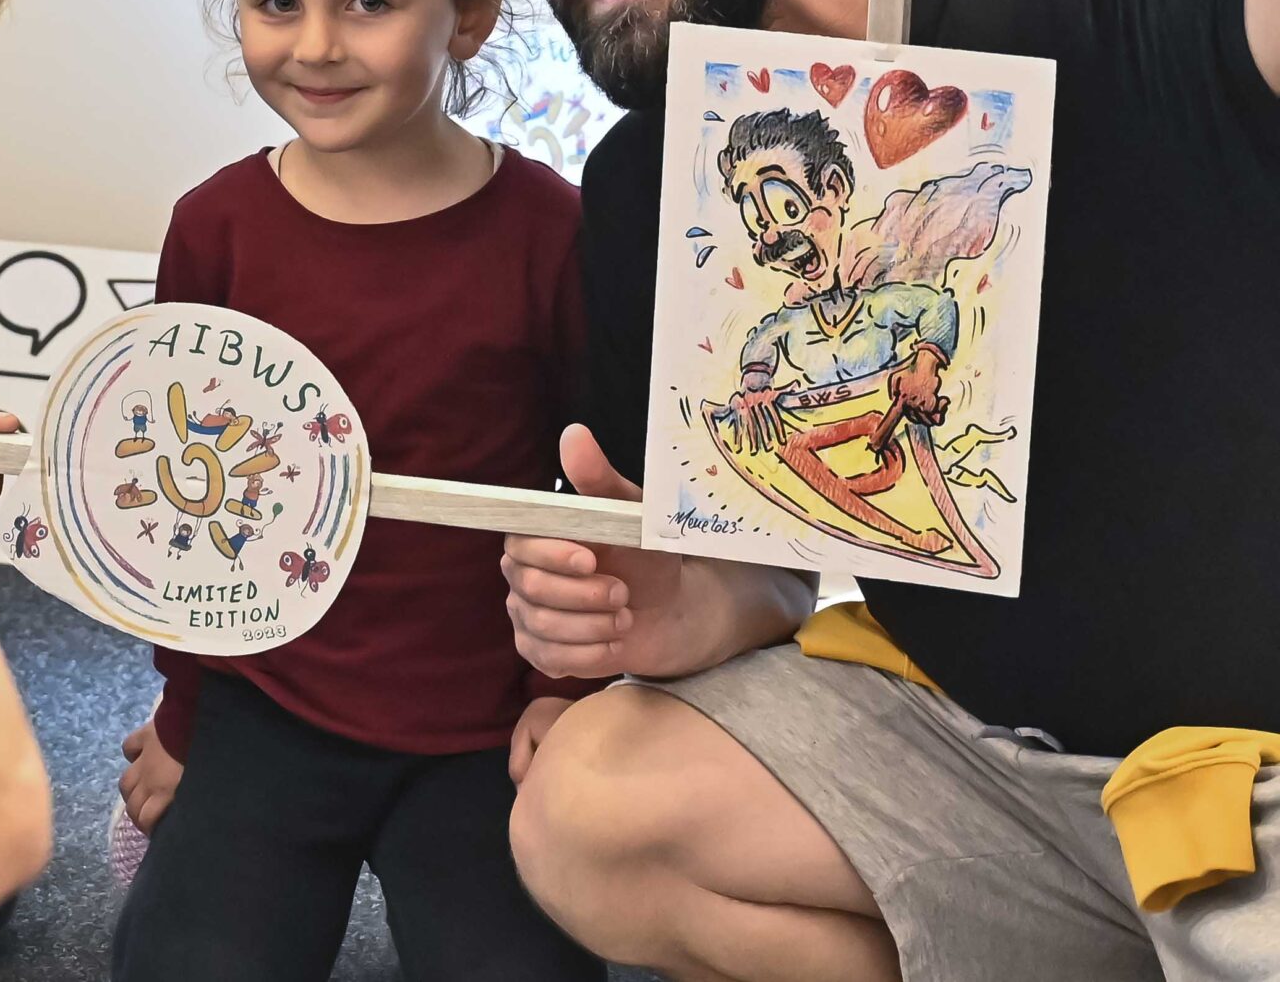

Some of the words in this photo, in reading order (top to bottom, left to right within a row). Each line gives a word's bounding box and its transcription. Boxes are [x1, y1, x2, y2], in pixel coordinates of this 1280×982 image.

[148, 322, 321, 413] AIBWS
[162, 580, 258, 604] LIMITED
[189, 598, 280, 629] EDITION
[242, 624, 287, 642] 2023
